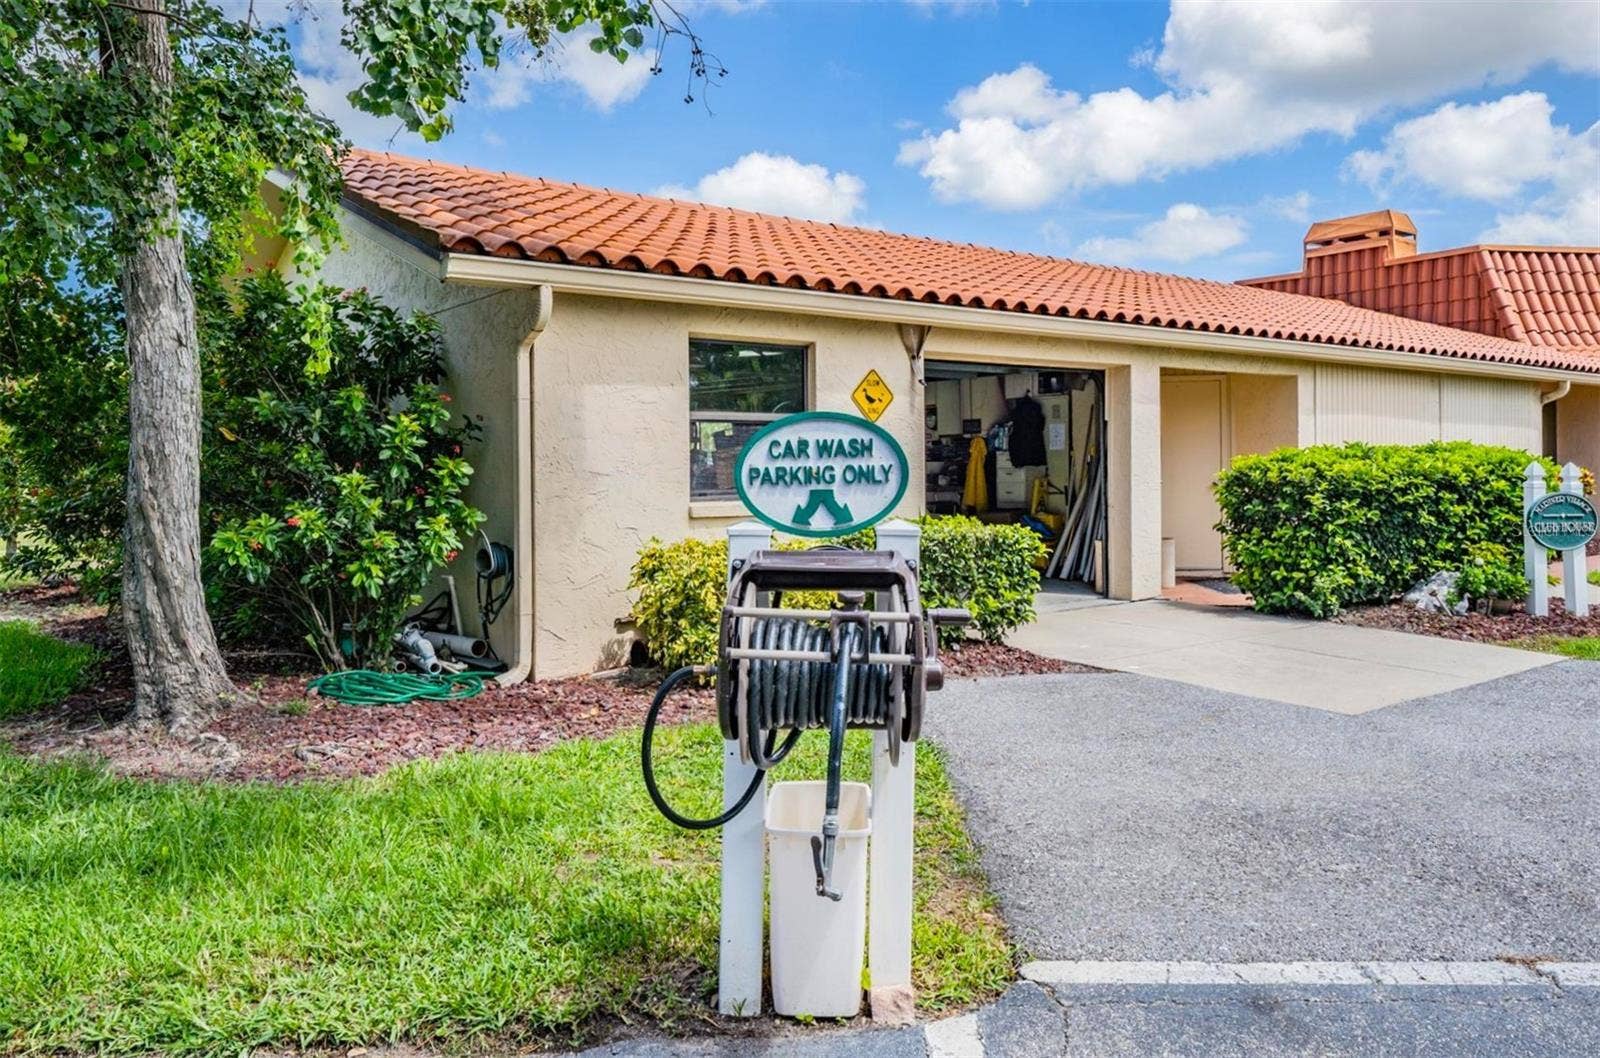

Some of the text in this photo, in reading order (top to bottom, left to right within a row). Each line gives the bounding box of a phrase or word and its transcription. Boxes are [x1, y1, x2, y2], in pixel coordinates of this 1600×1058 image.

[768, 438, 873, 460] CAR WASH
[748, 463, 893, 486] PARKING ONLY
[1562, 521, 1595, 533] HOUSE
